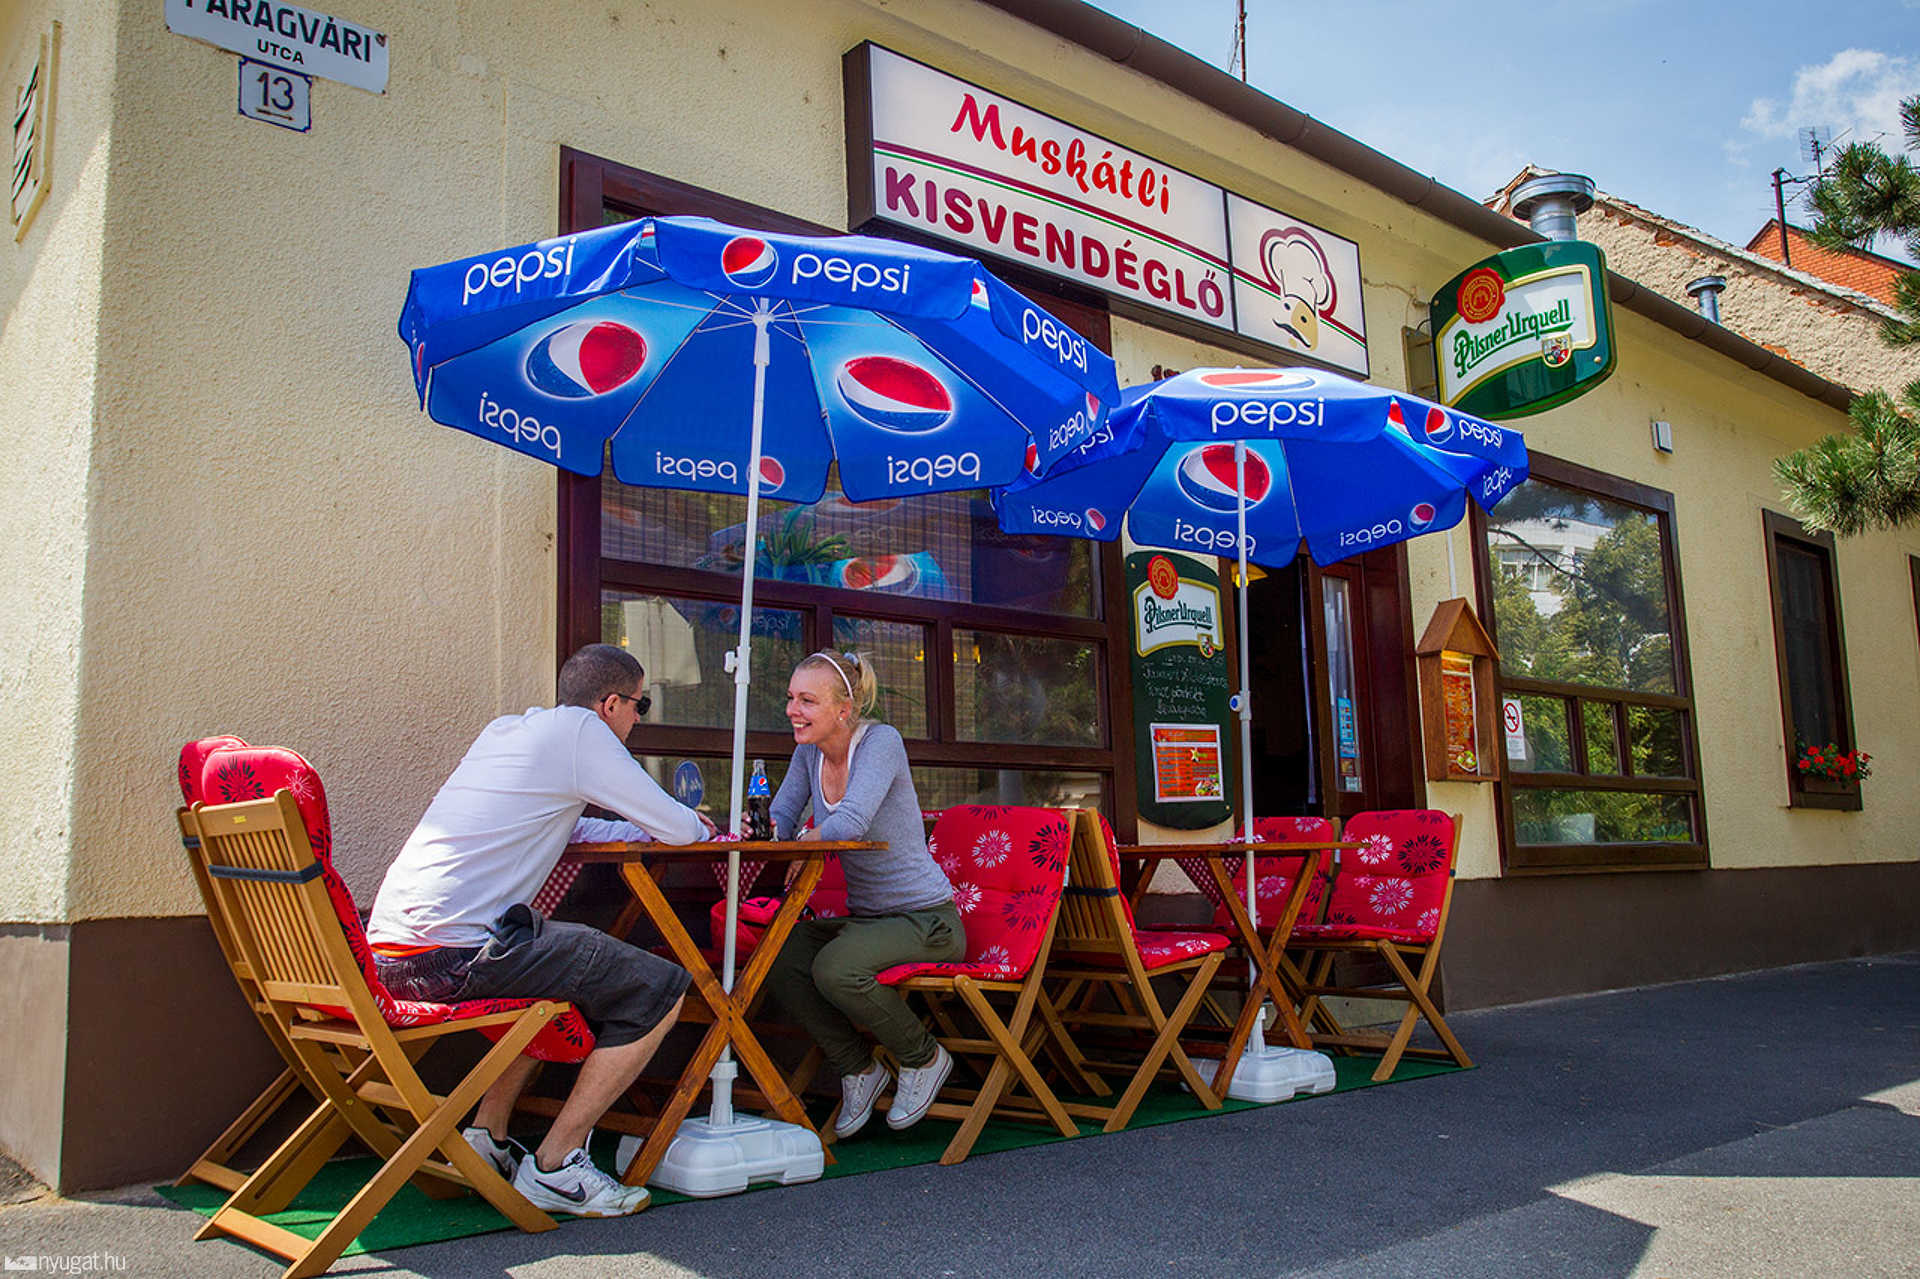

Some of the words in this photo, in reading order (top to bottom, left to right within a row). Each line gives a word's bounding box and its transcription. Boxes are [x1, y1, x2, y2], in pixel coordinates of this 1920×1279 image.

[184, 0, 371, 63] ARAGVÁRI
[257, 39, 305, 65] UTCA
[256, 71, 295, 111] 13
[950, 93, 1170, 215] Muskátli
[885, 167, 1224, 319] KISVENDÉGLŐ
[462, 236, 577, 306] pepsi
[791, 253, 911, 295] pepsi
[1022, 308, 1088, 374] pepsi
[1211, 396, 1325, 434] pepsi
[1458, 418, 1503, 449] pepsi
